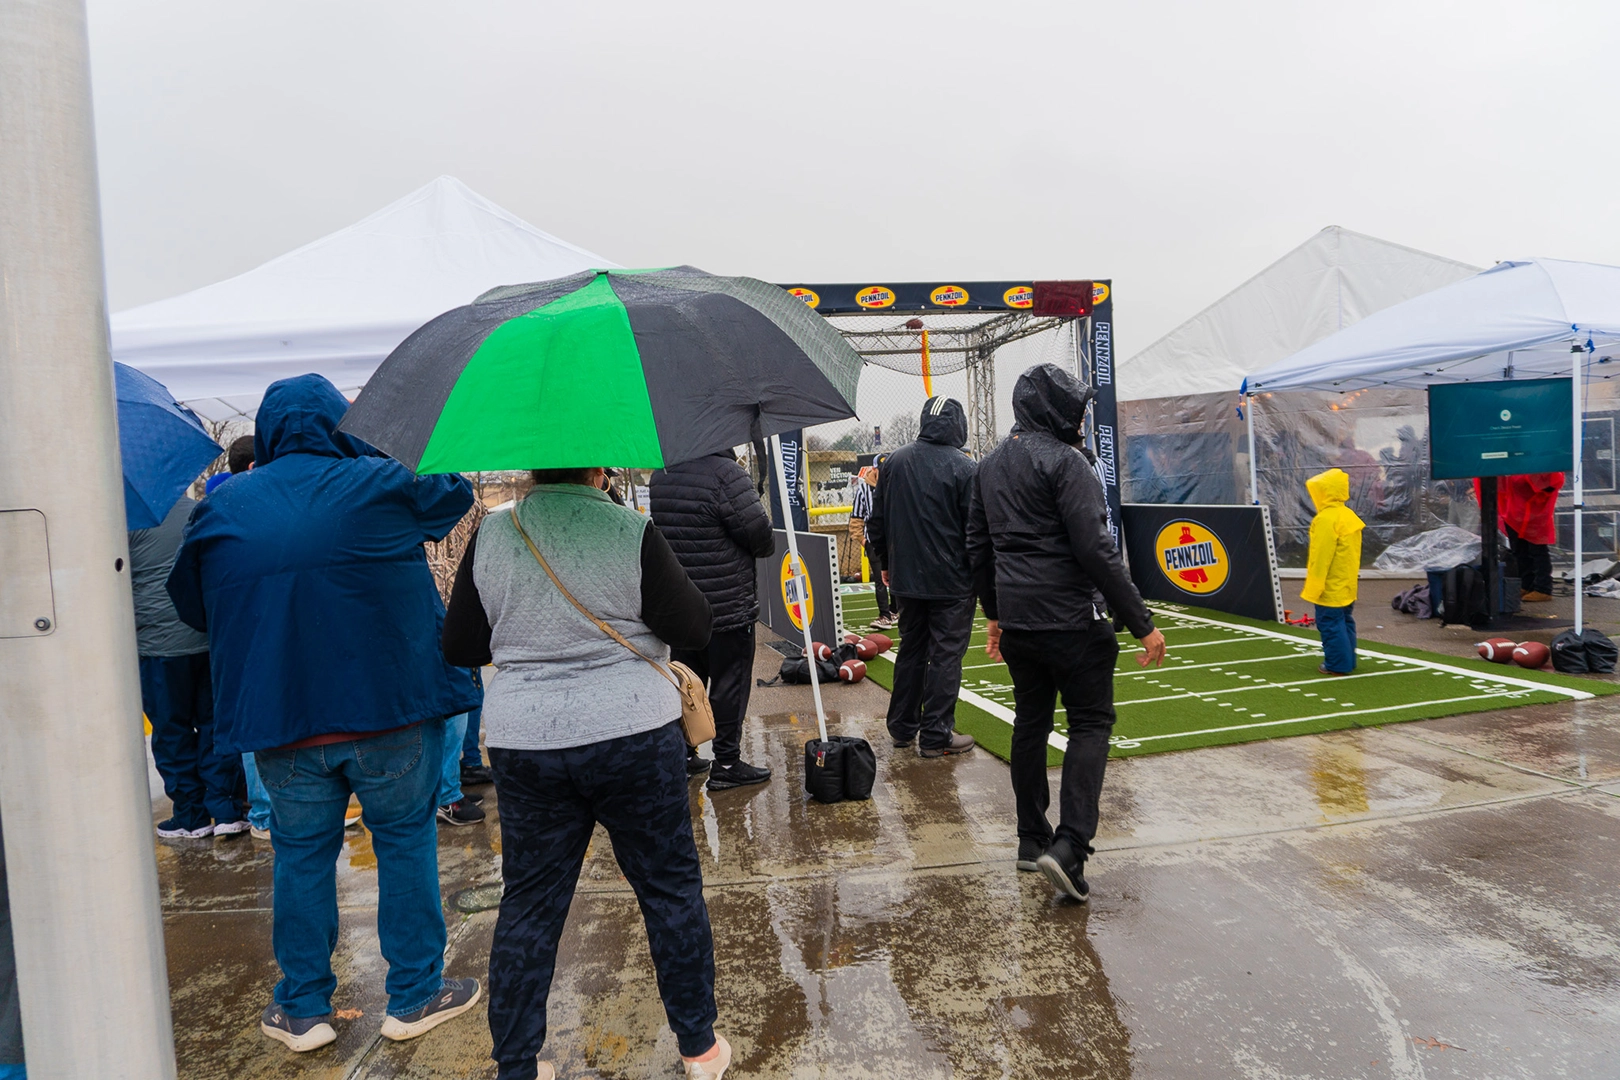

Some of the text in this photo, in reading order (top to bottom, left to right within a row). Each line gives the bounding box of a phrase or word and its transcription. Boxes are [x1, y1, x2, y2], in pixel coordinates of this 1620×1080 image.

[860, 292, 890, 303] PENNZOIL
[935, 291, 964, 302] PENNZOIL
[1008, 292, 1033, 302] PENNZOI
[1095, 321, 1111, 387] PENNZOIL
[1164, 541, 1218, 571] PENNZOIL
